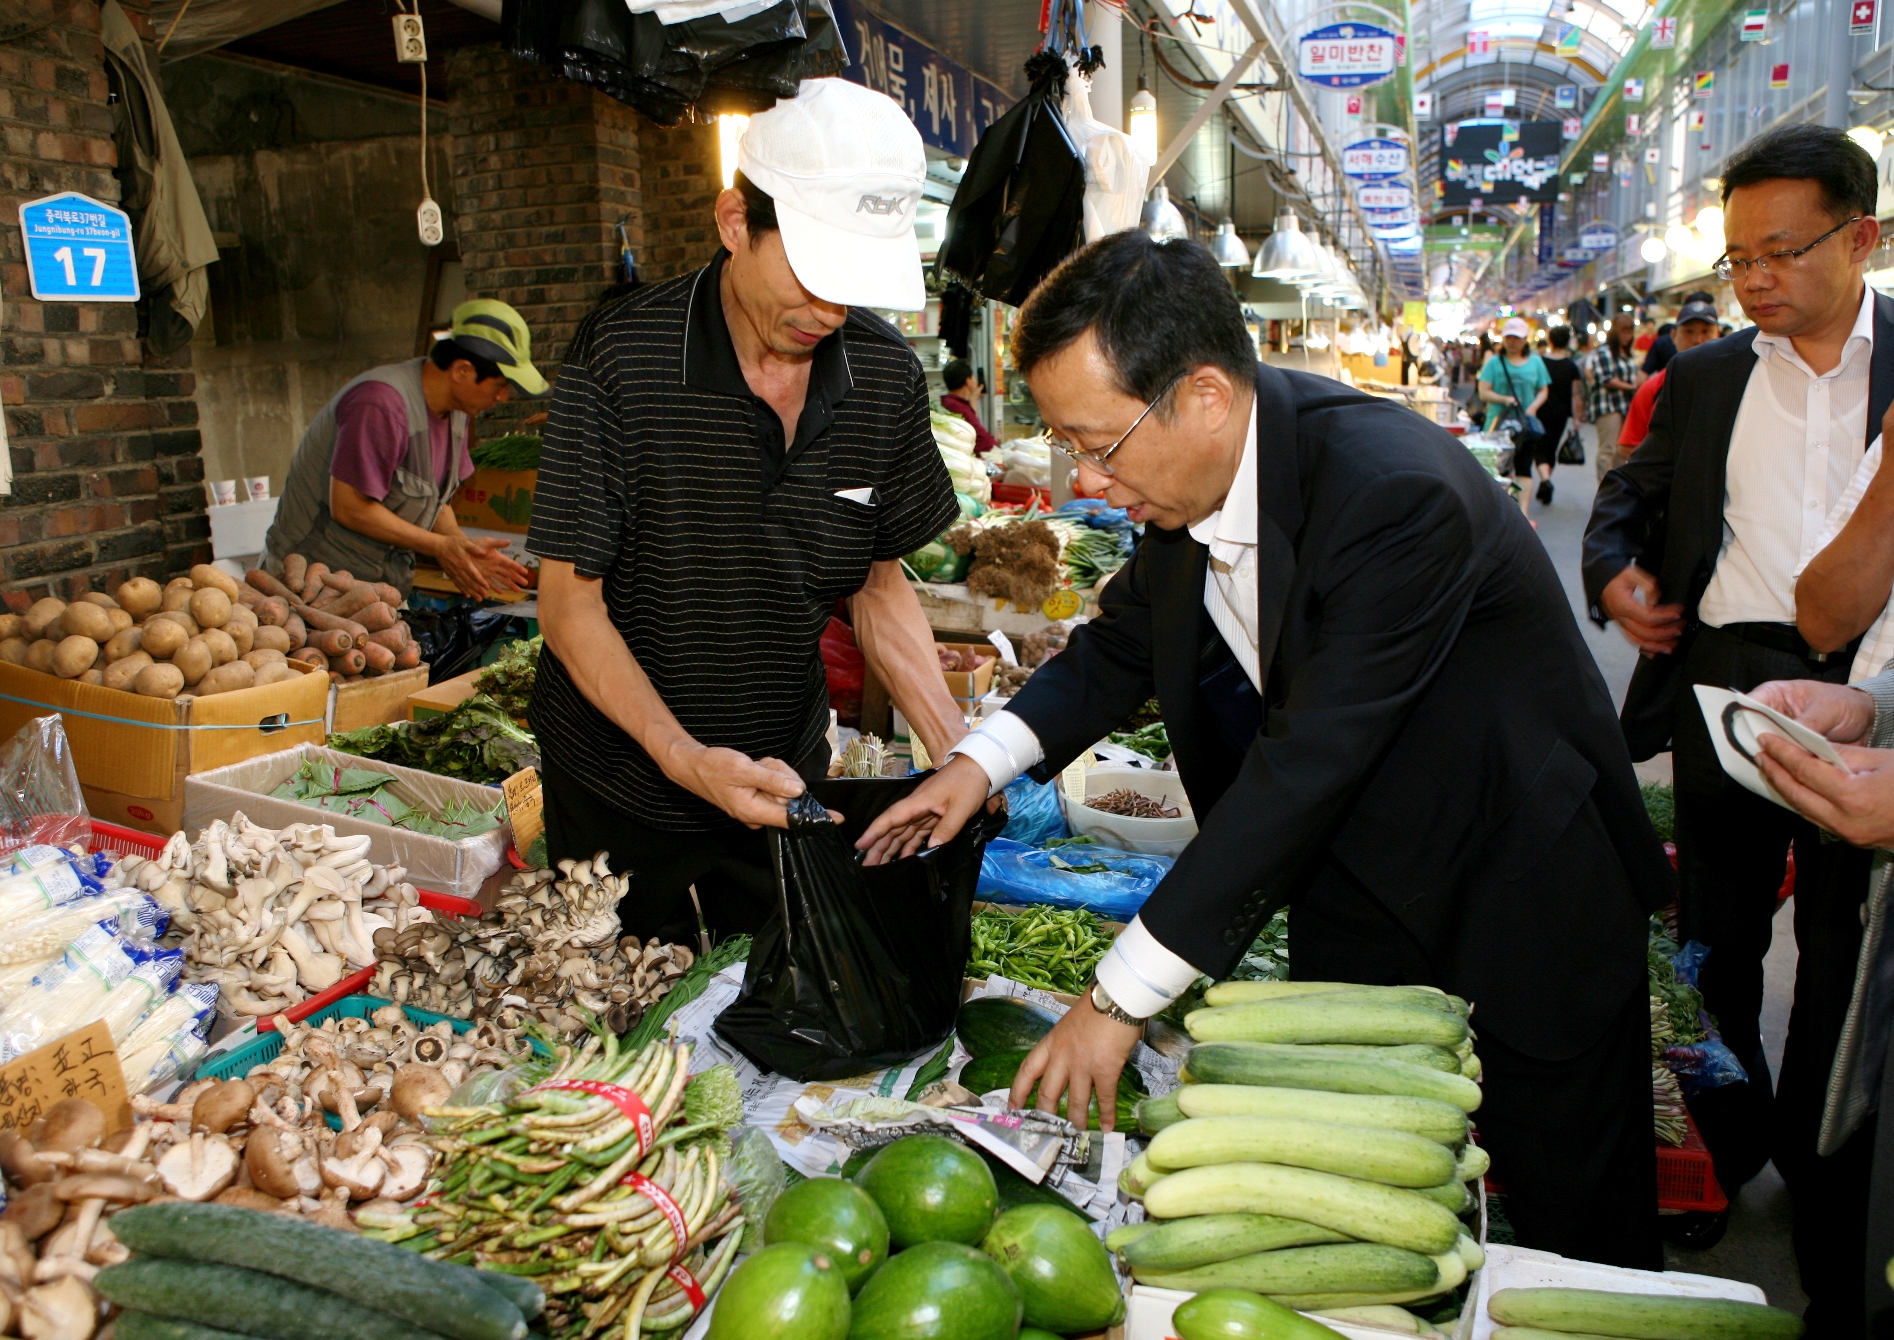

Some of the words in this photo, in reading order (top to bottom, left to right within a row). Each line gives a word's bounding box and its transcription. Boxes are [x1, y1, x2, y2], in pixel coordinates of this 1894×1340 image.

[1310, 44, 1384, 64] 일미반찬
[46, 209, 107, 227] 중리북로37번길
[85, 227, 121, 238] 37beon-gil
[53, 246, 107, 287] 17
